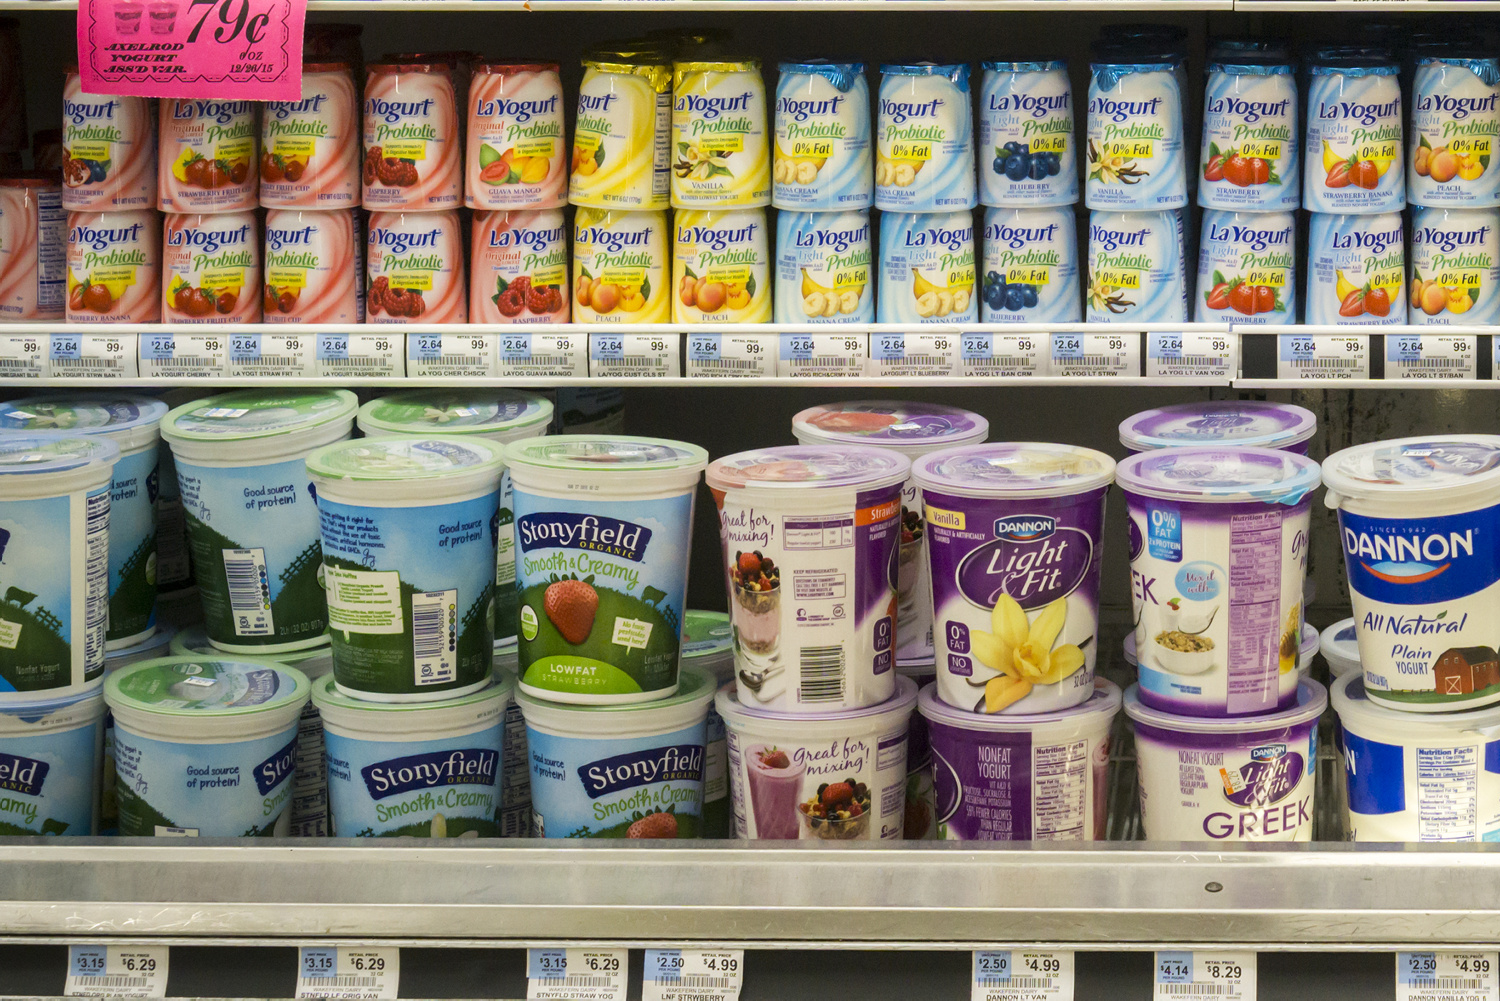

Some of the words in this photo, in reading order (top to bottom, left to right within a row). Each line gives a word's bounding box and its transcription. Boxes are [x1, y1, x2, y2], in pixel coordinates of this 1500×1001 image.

[104, 43, 184, 51] AXELROD
[249, 52, 263, 60] OZ
[152, 65, 187, 73] VAR.
[230, 64, 274, 73] 12/26/15
[692, 117, 752, 134] Probiotic
[377, 125, 436, 142] Probiotic
[795, 142, 810, 154] 0%
[813, 142, 830, 154] Fat
[692, 182, 724, 190] VANILLA
[521, 514, 641, 551] Stonyfield
[1347, 529, 1473, 560] DANNON
[524, 556, 568, 576] Smooth
[577, 554, 640, 587] Creamy
[1363, 612, 1387, 632] All
[1386, 612, 1467, 635] Natural
[1391, 645, 1431, 661] Plain
[1396, 662, 1428, 675] YOGURT
[372, 752, 495, 790] Stonyfield
[1203, 795, 1308, 838] GREEK
[123, 957, 155, 971] $6.29
[1207, 965, 1241, 979] $8.29
